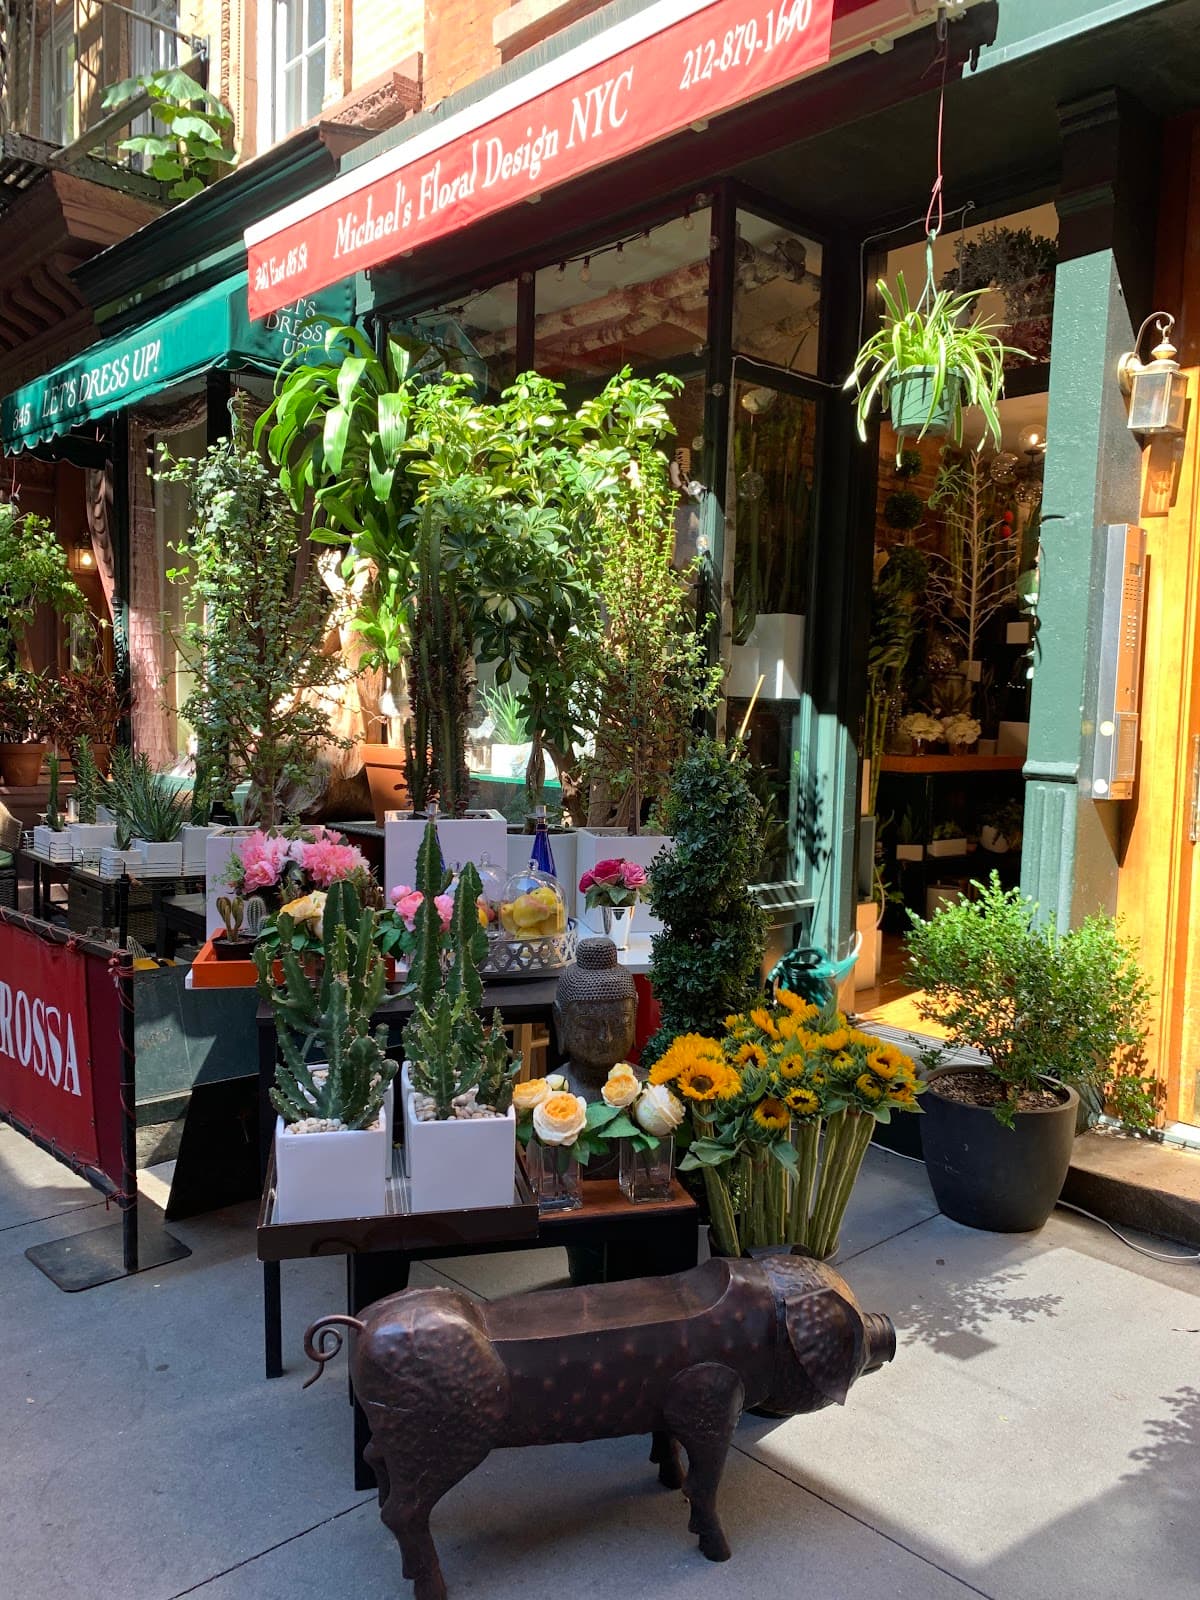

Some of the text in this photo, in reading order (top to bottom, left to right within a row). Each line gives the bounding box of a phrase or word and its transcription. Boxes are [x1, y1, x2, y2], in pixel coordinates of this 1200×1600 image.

[679, 0, 812, 90] 212-879-1690
[333, 65, 634, 259] Michael's Floral Design NYC
[12, 402, 31, 431] 345
[41, 339, 161, 418] LET'S DRESS UP!
[0, 981, 82, 1097] ROSSA
